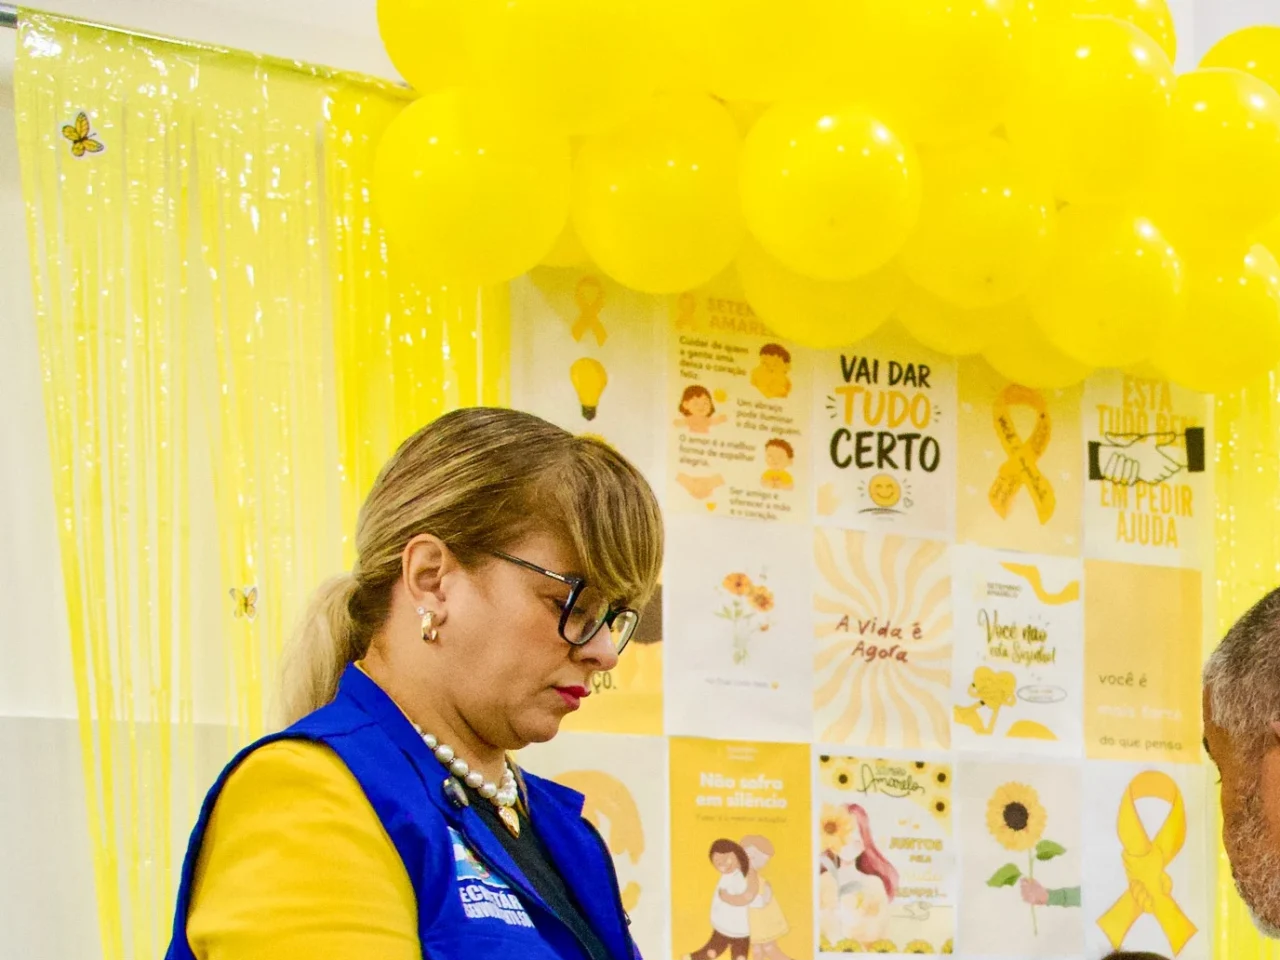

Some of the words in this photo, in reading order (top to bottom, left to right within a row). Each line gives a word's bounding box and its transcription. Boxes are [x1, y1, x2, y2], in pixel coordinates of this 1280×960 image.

[840, 354, 879, 385] VAI
[888, 361, 931, 389] DAR
[834, 386, 931, 430] TUDO
[830, 428, 940, 472] CERTO
[1100, 479, 1128, 510] EM
[1135, 481, 1193, 517] PEDIR
[1116, 511, 1178, 549] AJUDA
[835, 614, 849, 632] A
[858, 616, 903, 640] Vida
[911, 621, 923, 640] é
[977, 608, 1018, 643] Você
[851, 640, 908, 663] Agora
[1098, 671, 1134, 687] você
[1138, 672, 1148, 688] é
[1099, 735, 1115, 746] do
[1118, 738, 1140, 749] que
[1144, 740, 1183, 751] pensa
[699, 772, 736, 790] Não
[739, 774, 783, 791] sofra
[696, 796, 723, 808] em
[726, 791, 788, 810] silêncio
